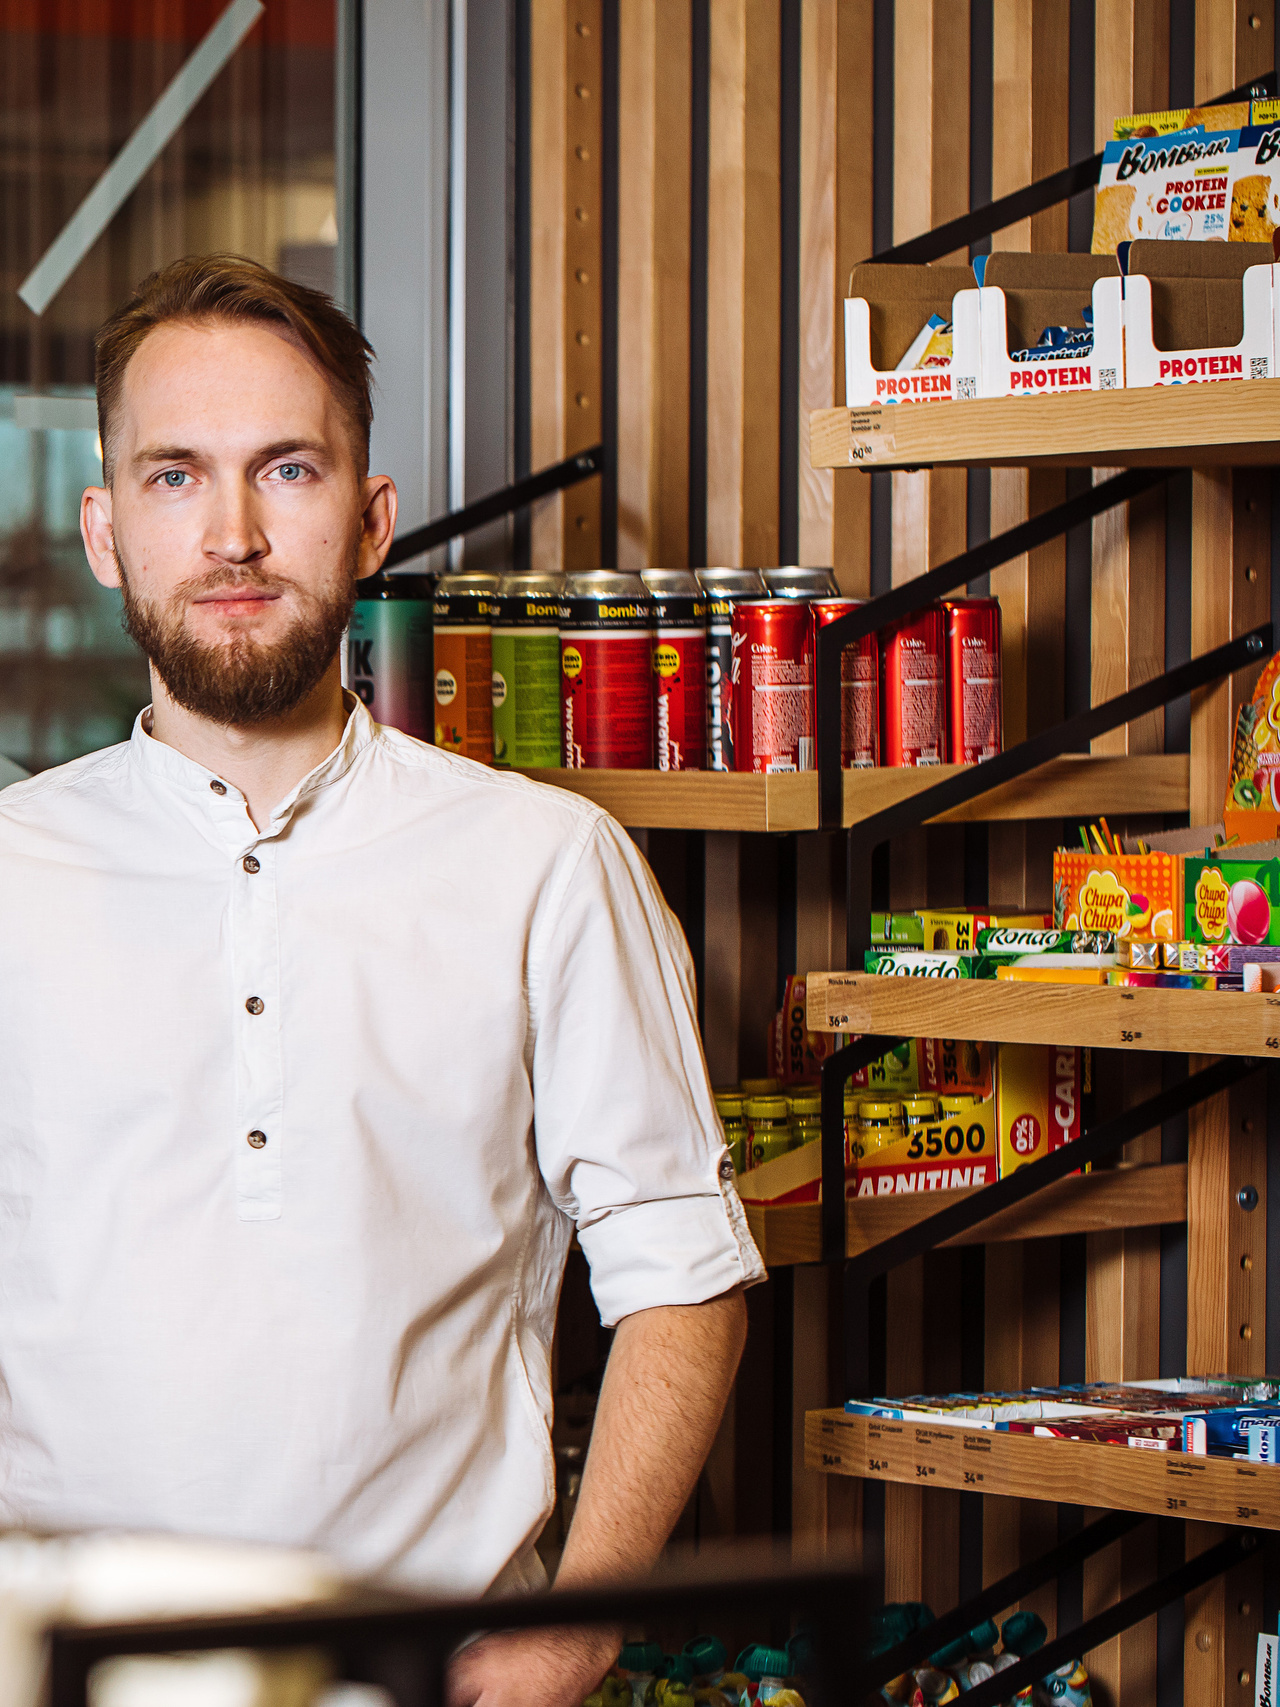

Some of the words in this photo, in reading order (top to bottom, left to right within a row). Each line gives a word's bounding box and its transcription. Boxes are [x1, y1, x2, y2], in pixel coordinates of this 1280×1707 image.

[1165, 177, 1228, 195] PROTEIN
[1156, 193, 1226, 214] COOKIE
[1204, 213, 1224, 224] 25%
[1010, 366, 1091, 389] PROTEIN
[1160, 355, 1242, 378] PROTEIN
[876, 374, 951, 395] PROTEIN
[657, 694, 670, 772] GUARANA
[1085, 887, 1124, 912] Chupa
[1199, 884, 1226, 906] Chupa
[1083, 908, 1123, 932] Chups
[1198, 901, 1226, 924] Chups
[988, 926, 1061, 949] Rondo
[877, 957, 962, 979] Rondo
[1121, 1030, 1133, 1042] 36
[907, 1123, 986, 1159] 3500
